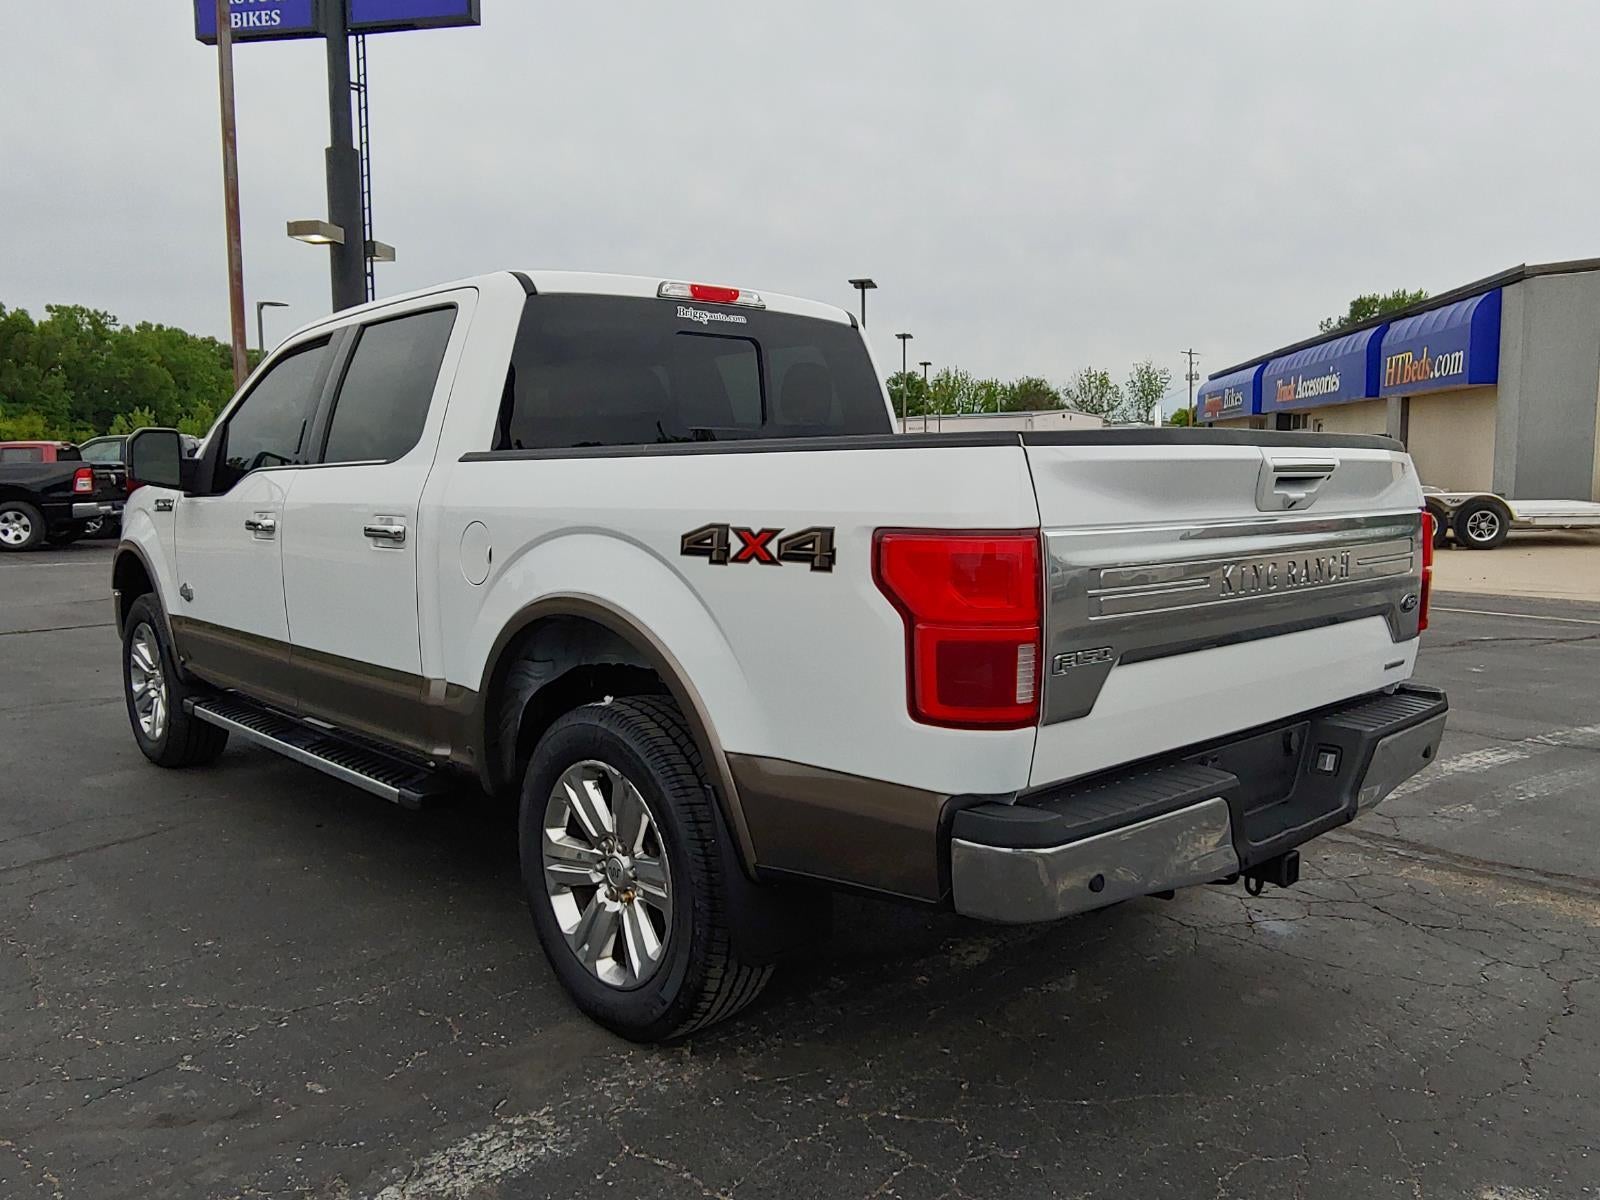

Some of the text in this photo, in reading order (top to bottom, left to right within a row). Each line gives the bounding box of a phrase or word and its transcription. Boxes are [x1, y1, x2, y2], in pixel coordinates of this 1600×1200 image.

[230, 9, 281, 28] BIKES
[676, 306, 747, 325] Briggsauto.com
[1384, 346, 1464, 387] HTBeds.com
[1295, 365, 1341, 399] Accessories
[1223, 387, 1243, 409] Bikes
[1219, 550, 1351, 597] KING RANCH
